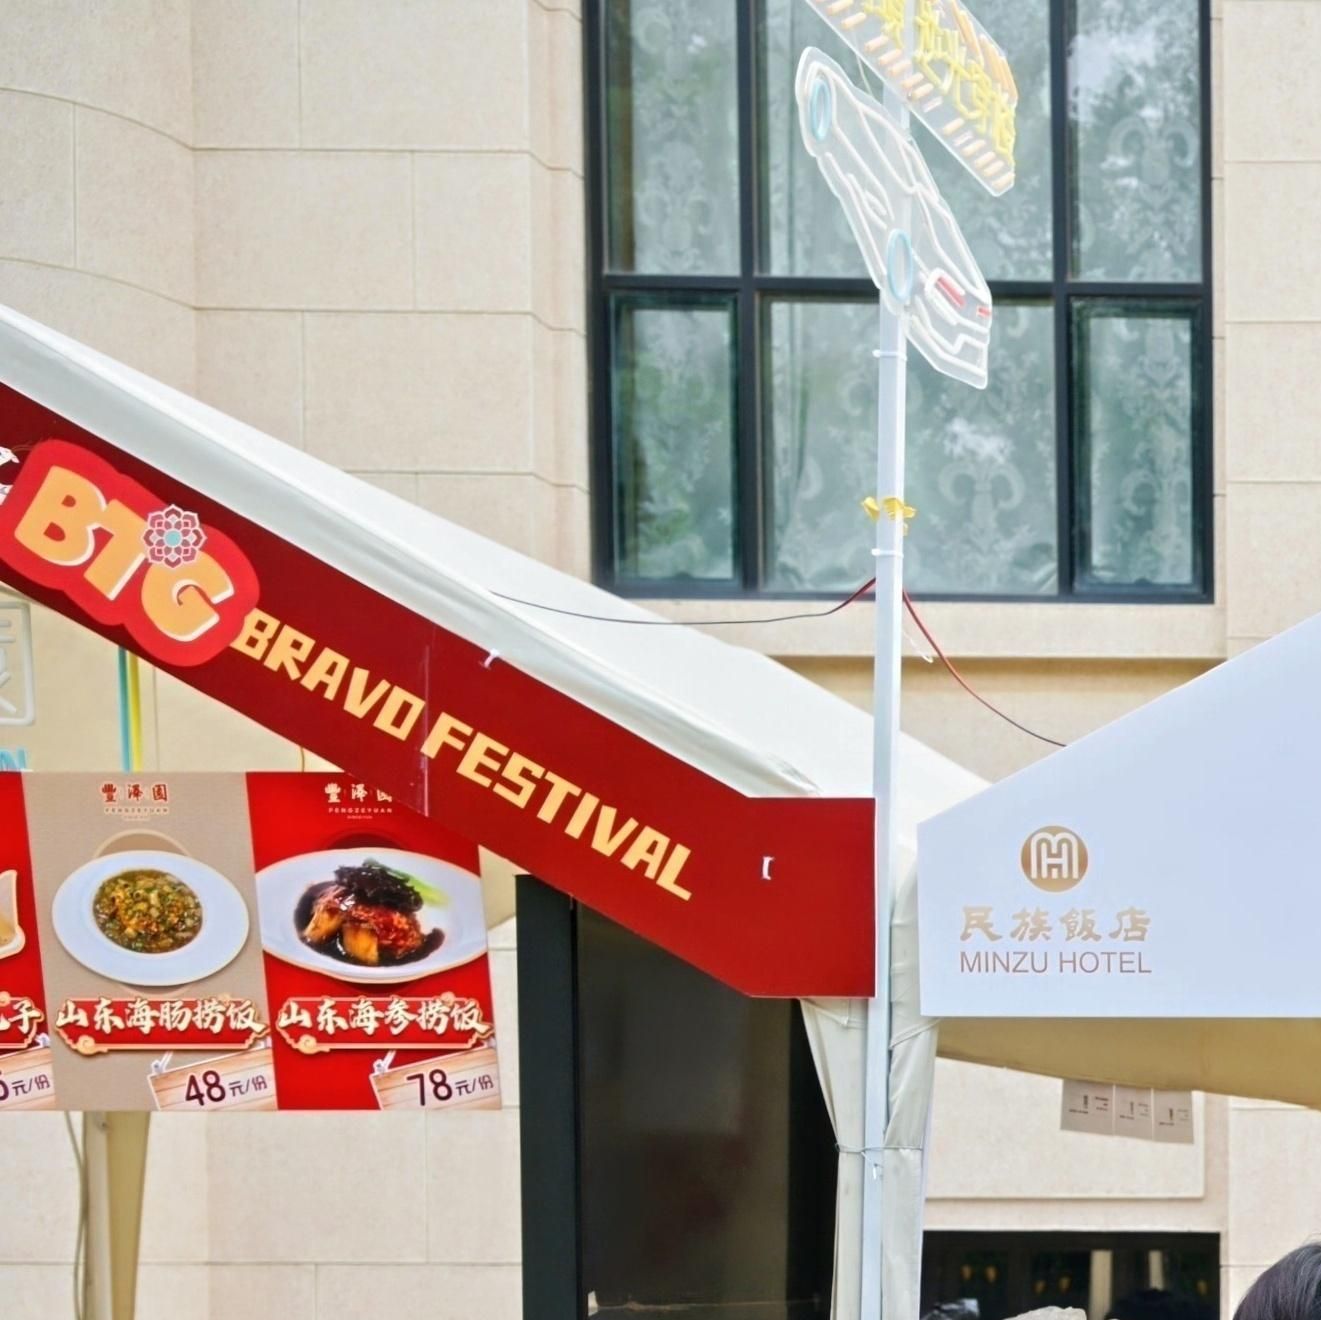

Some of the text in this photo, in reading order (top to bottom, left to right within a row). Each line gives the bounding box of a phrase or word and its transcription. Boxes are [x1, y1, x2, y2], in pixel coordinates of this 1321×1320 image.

[14, 465, 235, 642] BTG
[231, 606, 427, 742] BRAVO
[420, 710, 694, 901] FESTIVAL
[959, 950, 1153, 974] MINZU HOTEL
[55, 998, 268, 1036] 山东海肠捞饭
[277, 998, 493, 1036] 山东海参捞饭
[184, 1069, 268, 1107] 48元/份
[406, 1068, 494, 1107] 78元/份
